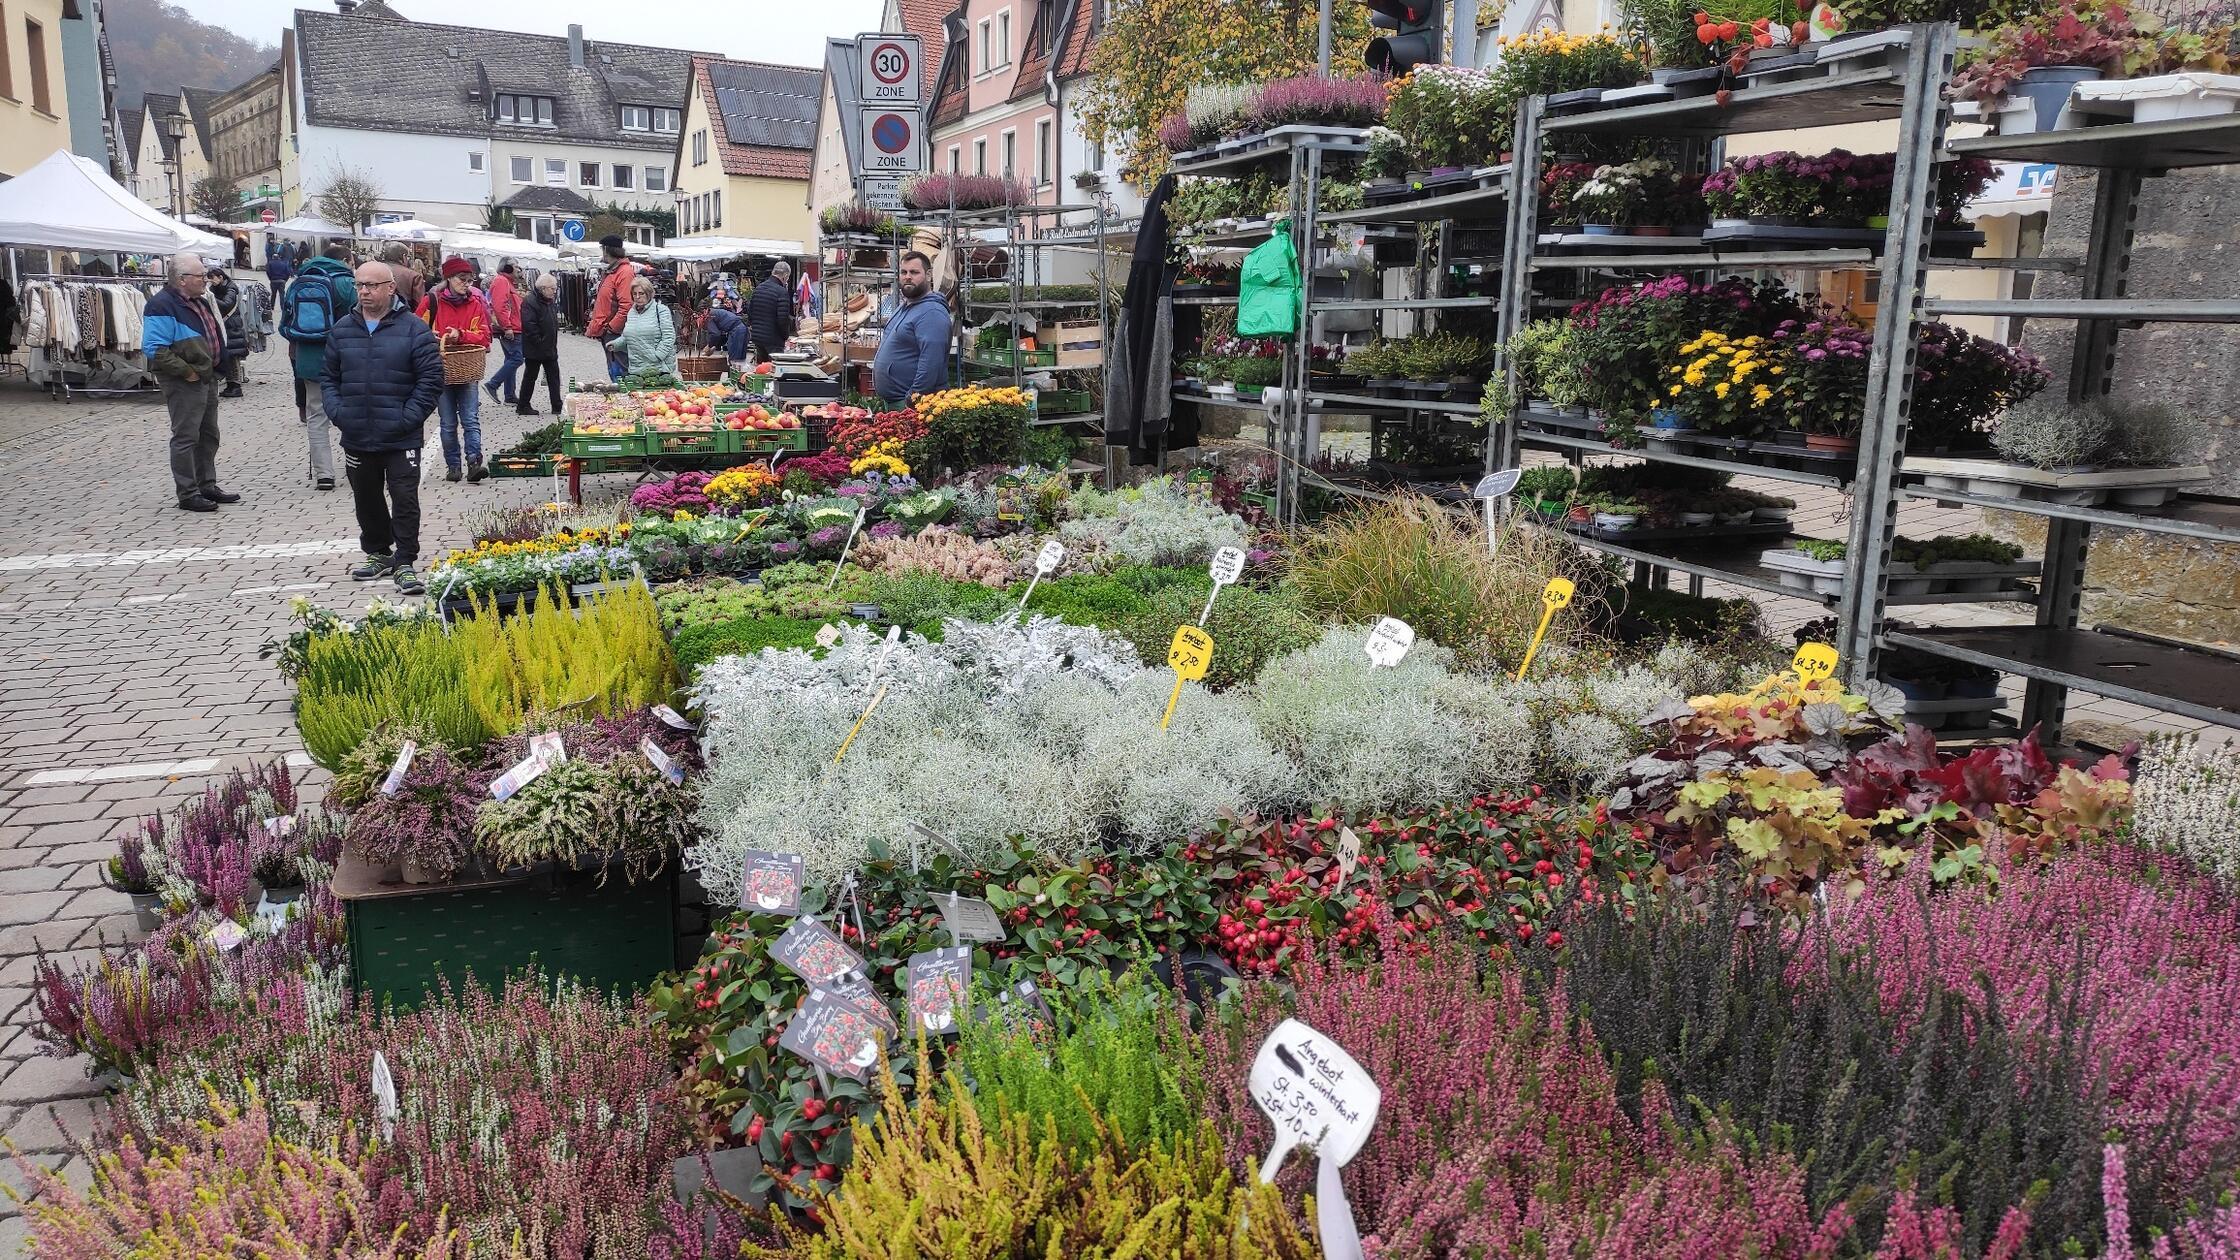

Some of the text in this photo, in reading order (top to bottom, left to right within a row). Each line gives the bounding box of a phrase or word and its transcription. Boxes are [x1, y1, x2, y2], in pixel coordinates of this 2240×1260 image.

[878, 54, 902, 73] 30
[876, 87, 905, 97] ZONE
[877, 157, 906, 167] ZONE
[1182, 629, 1206, 647] Angebot
[1180, 652, 1199, 671] 2,50
[1804, 658, 1829, 676] 3,90
[797, 1007, 824, 1044] Gaultheria
[1297, 1039, 1344, 1084] Angebot
[1273, 1076, 1318, 1117] St. 3,50
[1309, 1078, 1360, 1125] winterhart
